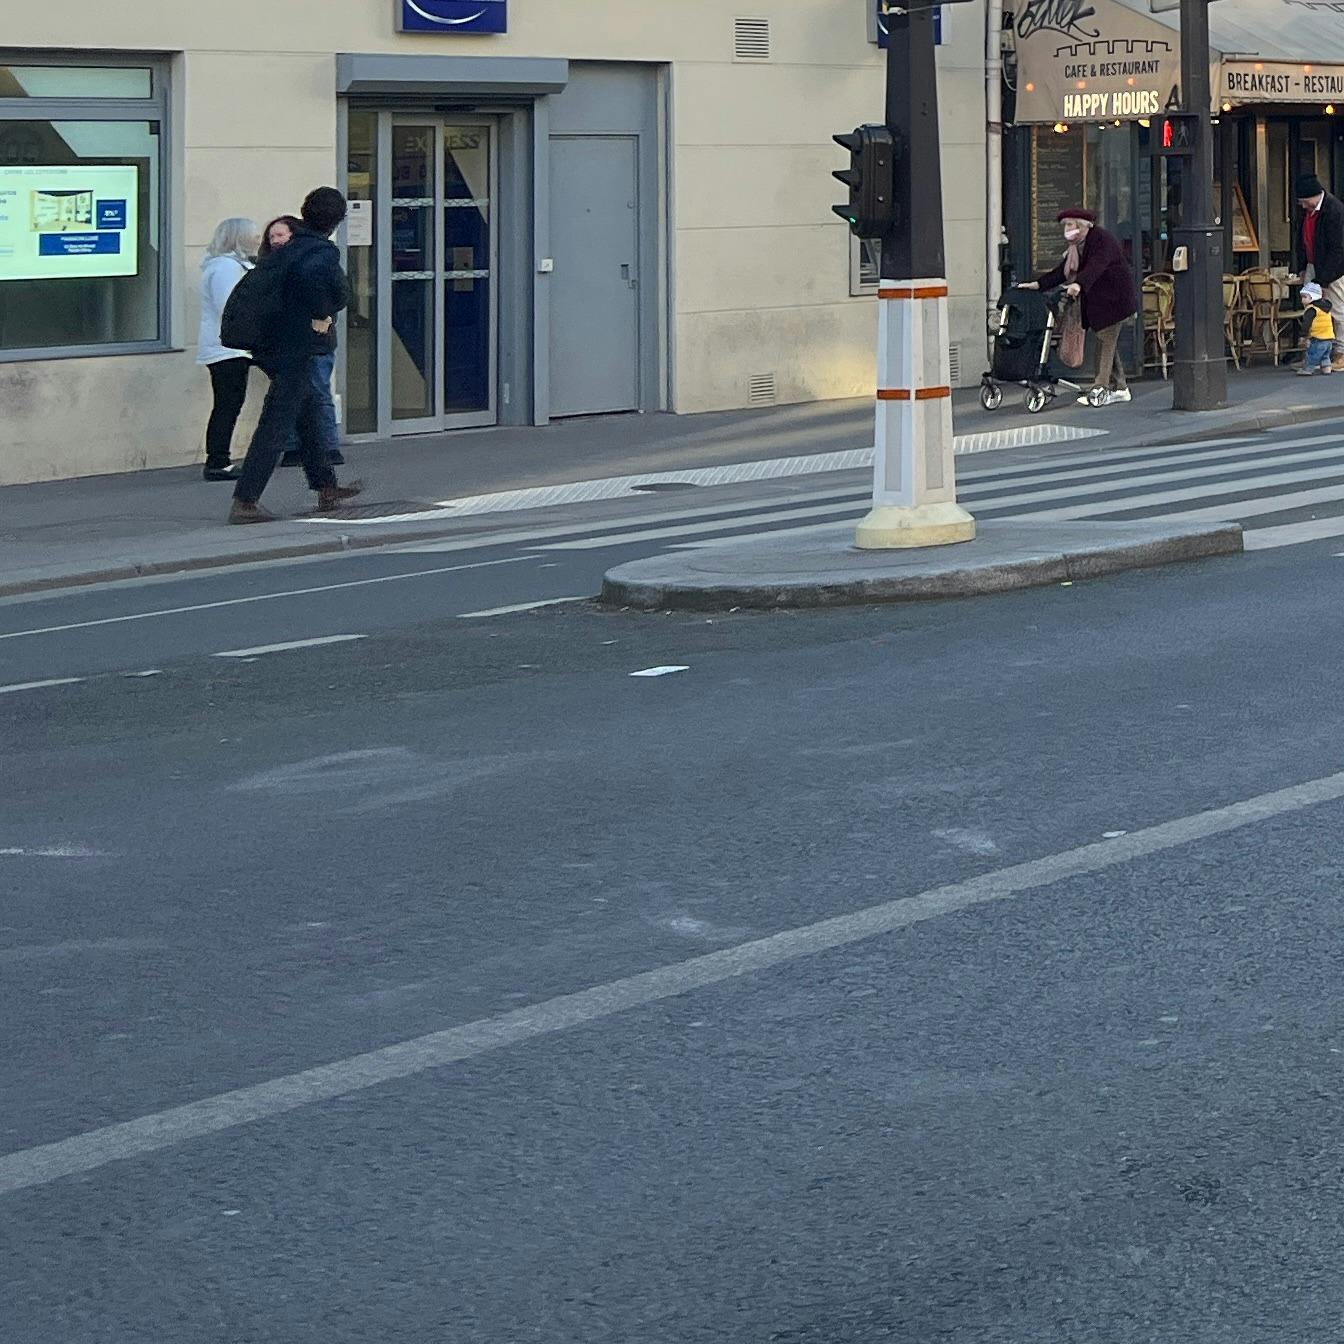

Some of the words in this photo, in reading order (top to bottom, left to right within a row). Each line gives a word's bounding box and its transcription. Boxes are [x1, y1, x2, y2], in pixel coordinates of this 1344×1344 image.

[1064, 64, 1088, 79] CAFE
[1090, 63, 1097, 77] &
[1099, 59, 1160, 77] RESTAURANT
[1227, 72, 1290, 93] BREAKFAST
[1063, 93, 1110, 118] HAPPY
[1112, 90, 1160, 115] HOURS
